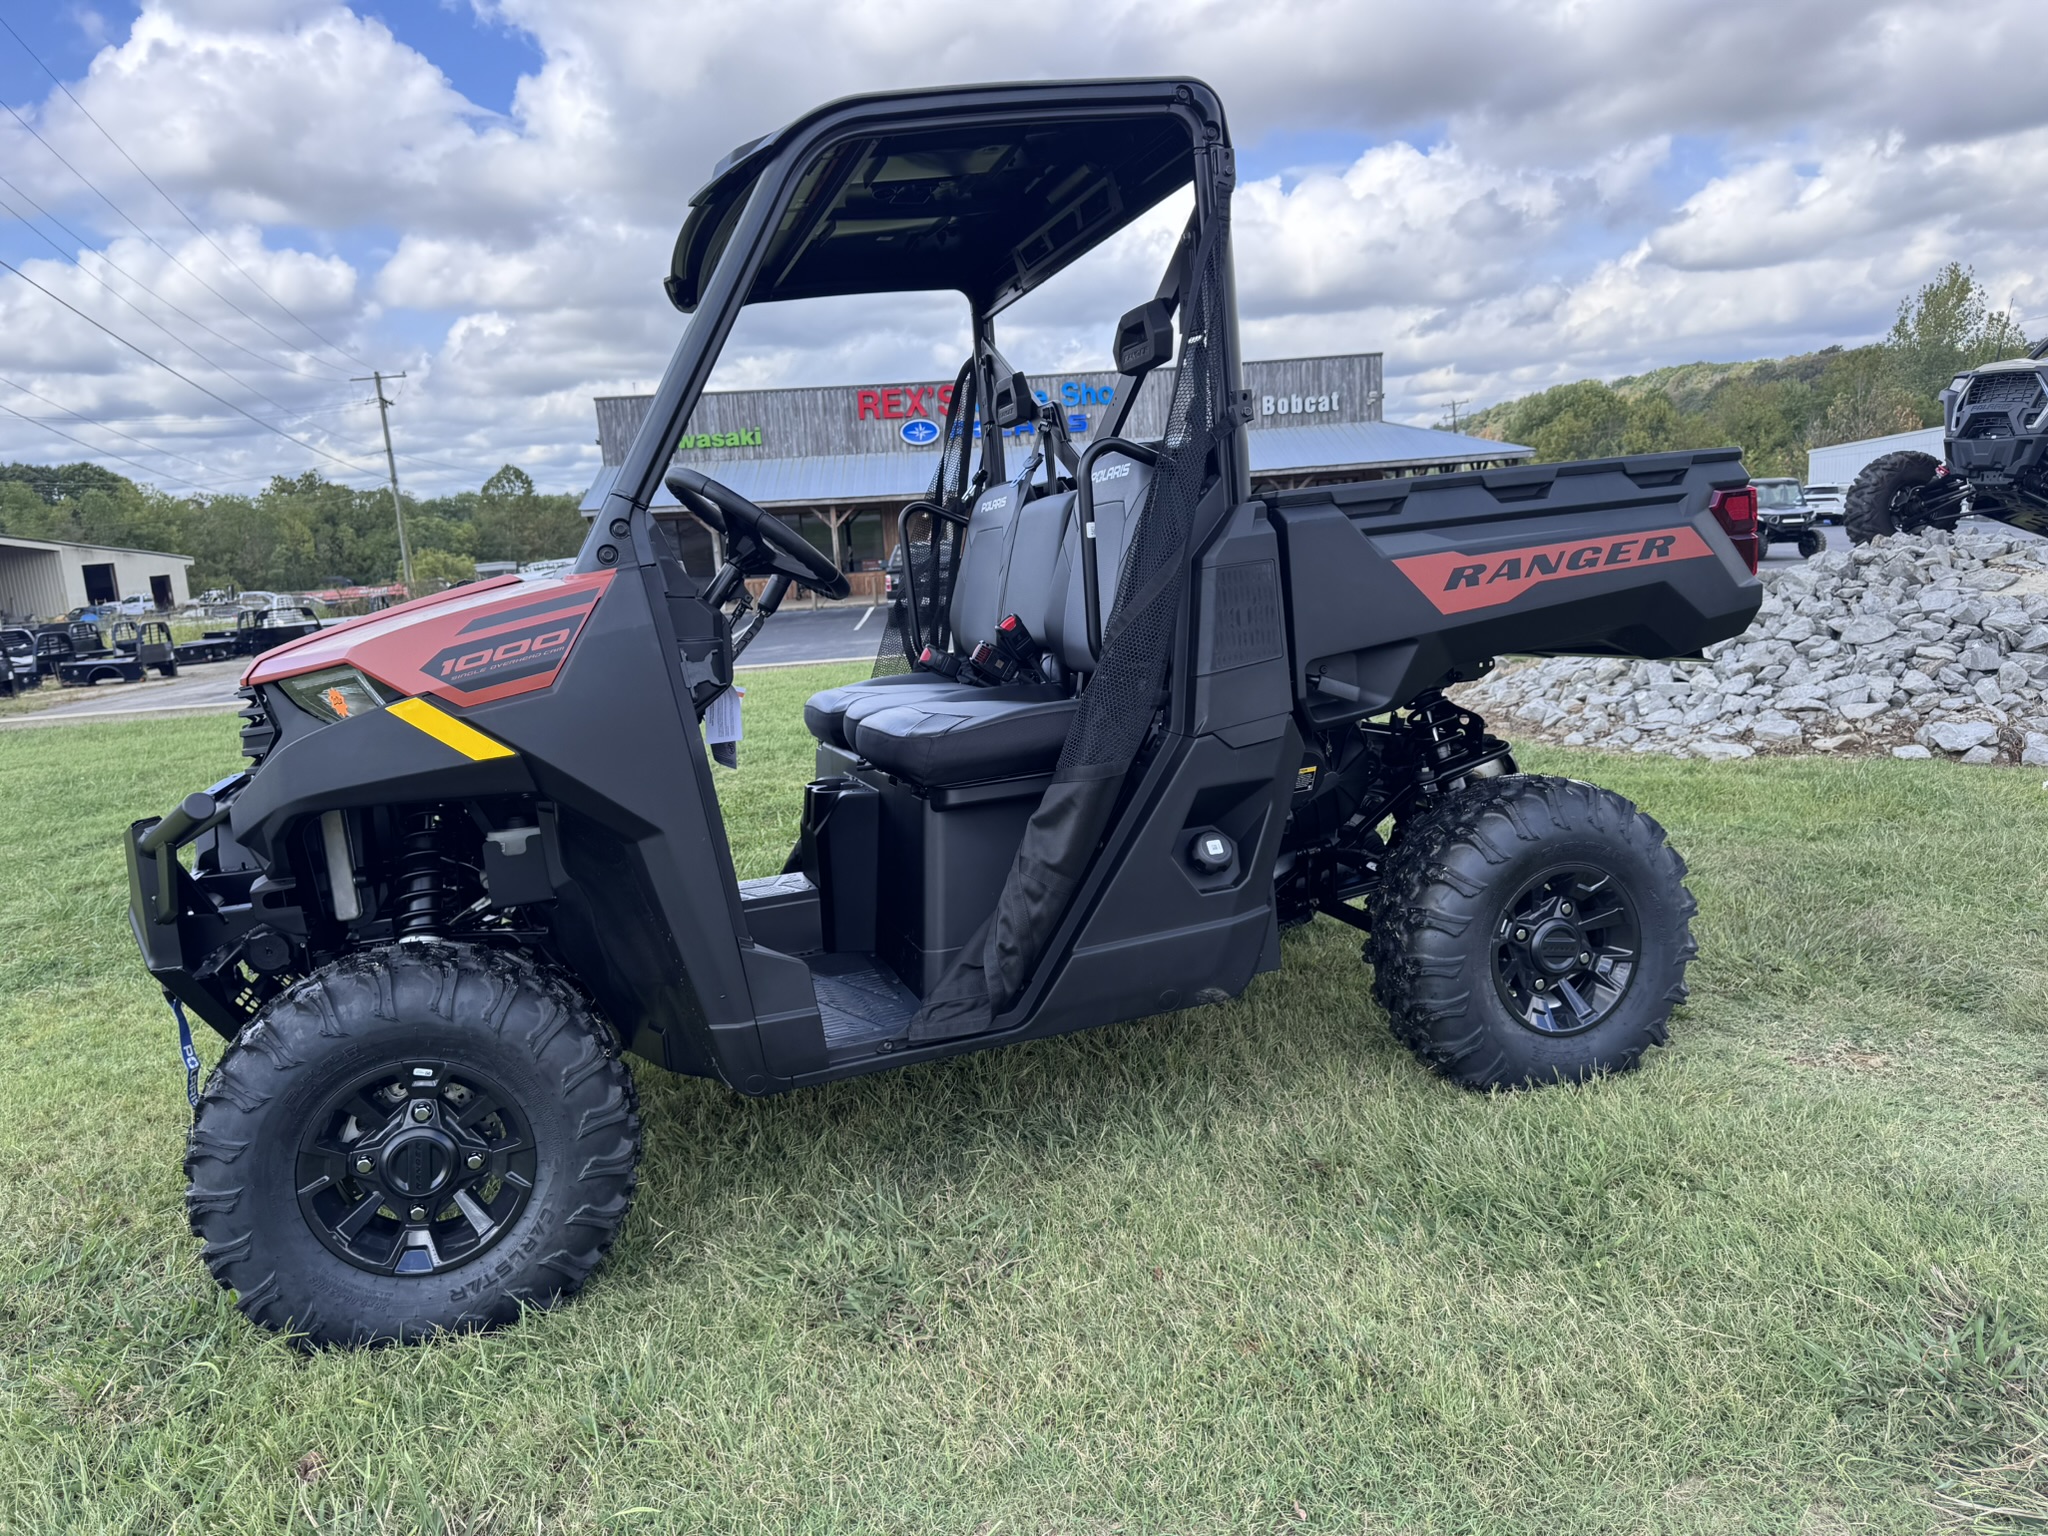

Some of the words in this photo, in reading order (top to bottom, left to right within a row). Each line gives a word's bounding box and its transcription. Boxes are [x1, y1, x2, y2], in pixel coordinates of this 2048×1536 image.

[857, 384, 956, 420] REX'S
[1061, 382, 1115, 408] Sho
[1262, 391, 1339, 416] Bobcat
[679, 426, 762, 449] wasaki
[1091, 463, 1131, 484] POLARIS
[981, 496, 1008, 513] POLARIS
[1443, 535, 1676, 591] RANGER
[440, 628, 570, 676] 1000
[450, 667, 487, 681] SINGLE
[490, 651, 542, 670] OVERHEAD
[543, 646, 565, 656] CAM
[183, 1044, 200, 1107] POLARIS
[449, 1207, 556, 1302] CARLSTAR
